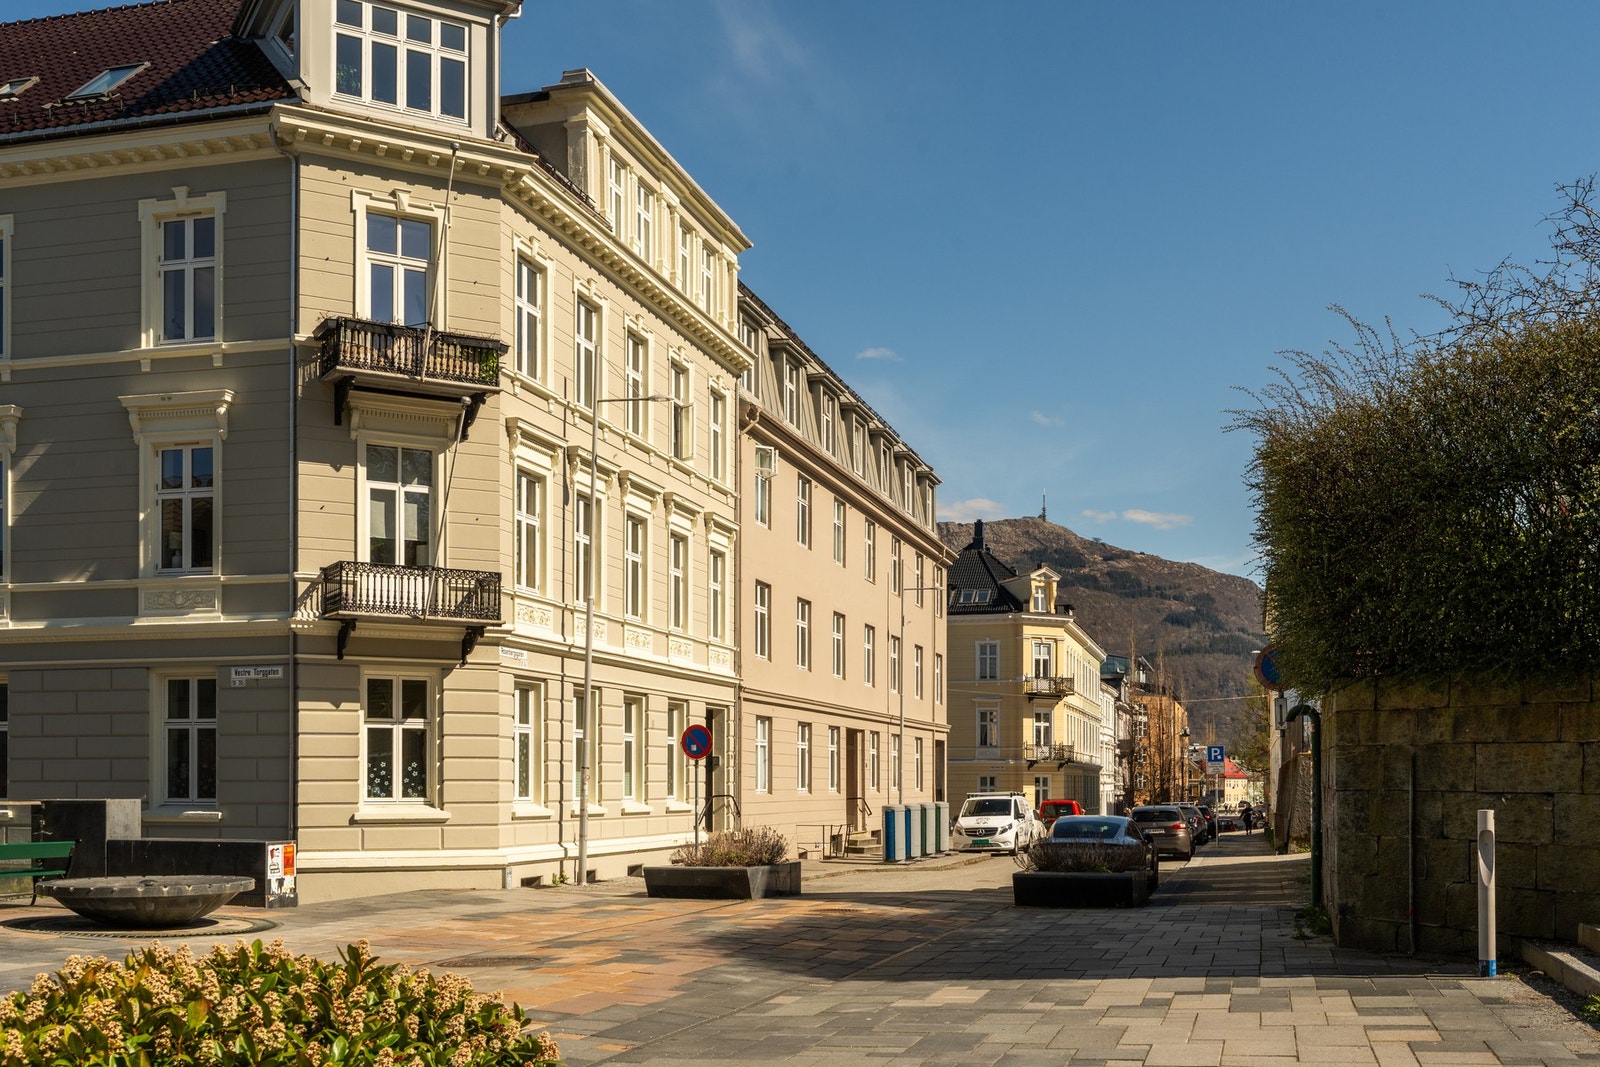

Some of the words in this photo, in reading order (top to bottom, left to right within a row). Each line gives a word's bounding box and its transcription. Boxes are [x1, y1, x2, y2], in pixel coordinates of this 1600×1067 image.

[234, 668, 251, 676] Vestre
[254, 668, 279, 677] Torggaten
[1211, 747, 1220, 760] P
